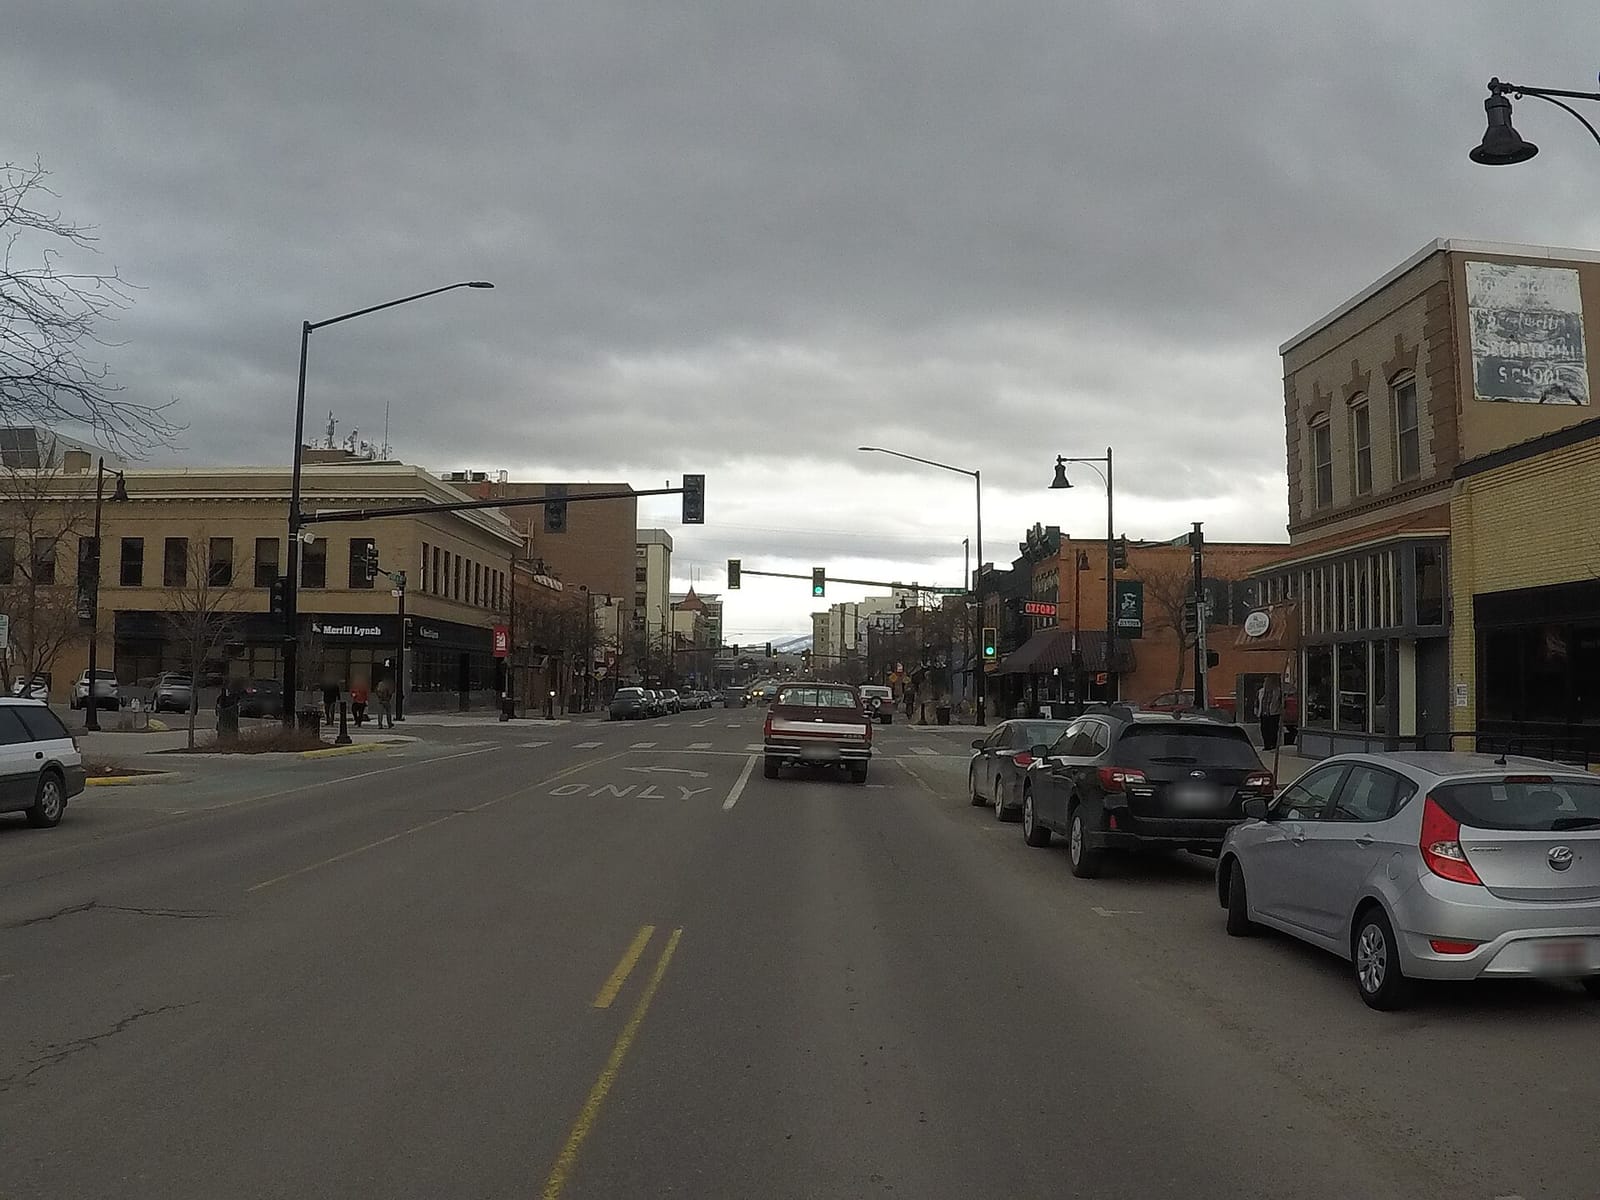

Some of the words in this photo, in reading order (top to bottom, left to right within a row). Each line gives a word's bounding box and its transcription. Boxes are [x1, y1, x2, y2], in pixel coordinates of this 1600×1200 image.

[1025, 603, 1056, 615] OXFORD
[323, 625, 352, 635] Merrill
[354, 626, 381, 637] Lynch
[549, 783, 712, 800] ONLY
